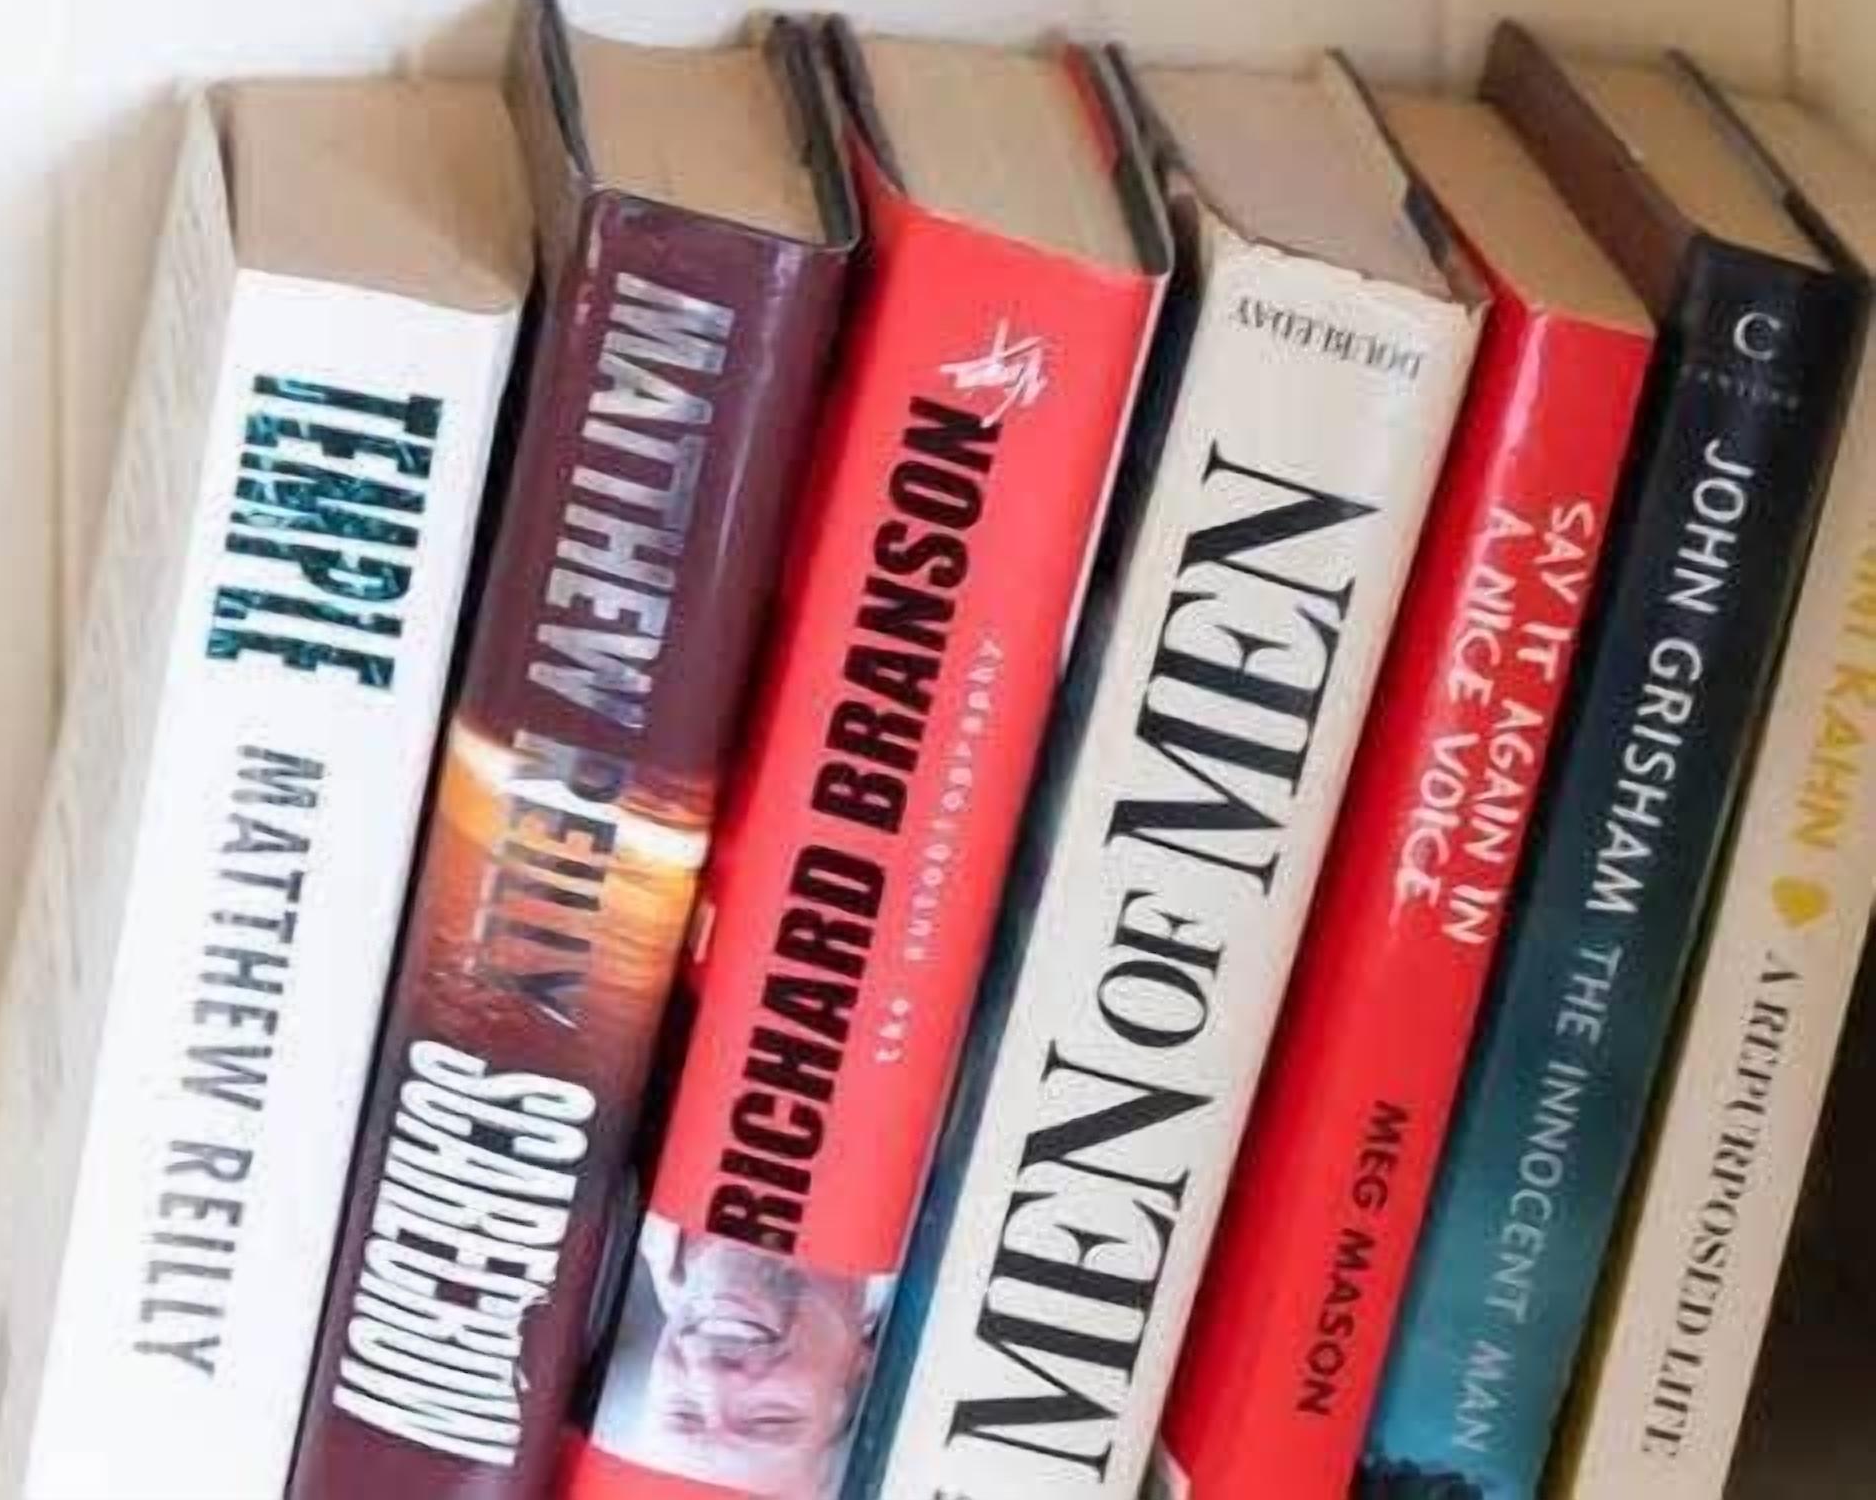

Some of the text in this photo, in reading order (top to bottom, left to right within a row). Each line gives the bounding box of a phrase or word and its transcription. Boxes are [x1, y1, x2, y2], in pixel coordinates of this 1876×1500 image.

[205, 374, 445, 691] TEMPLE
[459, 270, 736, 1032] MATTHEW REILLY
[1393, 506, 1535, 910] A NICE VOICE
[1442, 502, 1595, 945] SAY IT AGAIN IN
[1666, 438, 1756, 616] JOHN
[707, 843, 885, 1255] RICHARD
[811, 397, 1002, 836] BRANSON
[944, 440, 1385, 1486] MEN OF MEN
[1585, 637, 1704, 915] GRISHAM
[132, 740, 327, 1378] MATTHEW REILLY
[331, 1037, 598, 1468] SCARECROW
[1295, 1097, 1415, 1418] MEG MASON
[1450, 943, 1624, 1454] THE INNOCENT MAN
[1674, 999, 1791, 1338] REPURPOSED
[1641, 1346, 1704, 1460] LIFE
